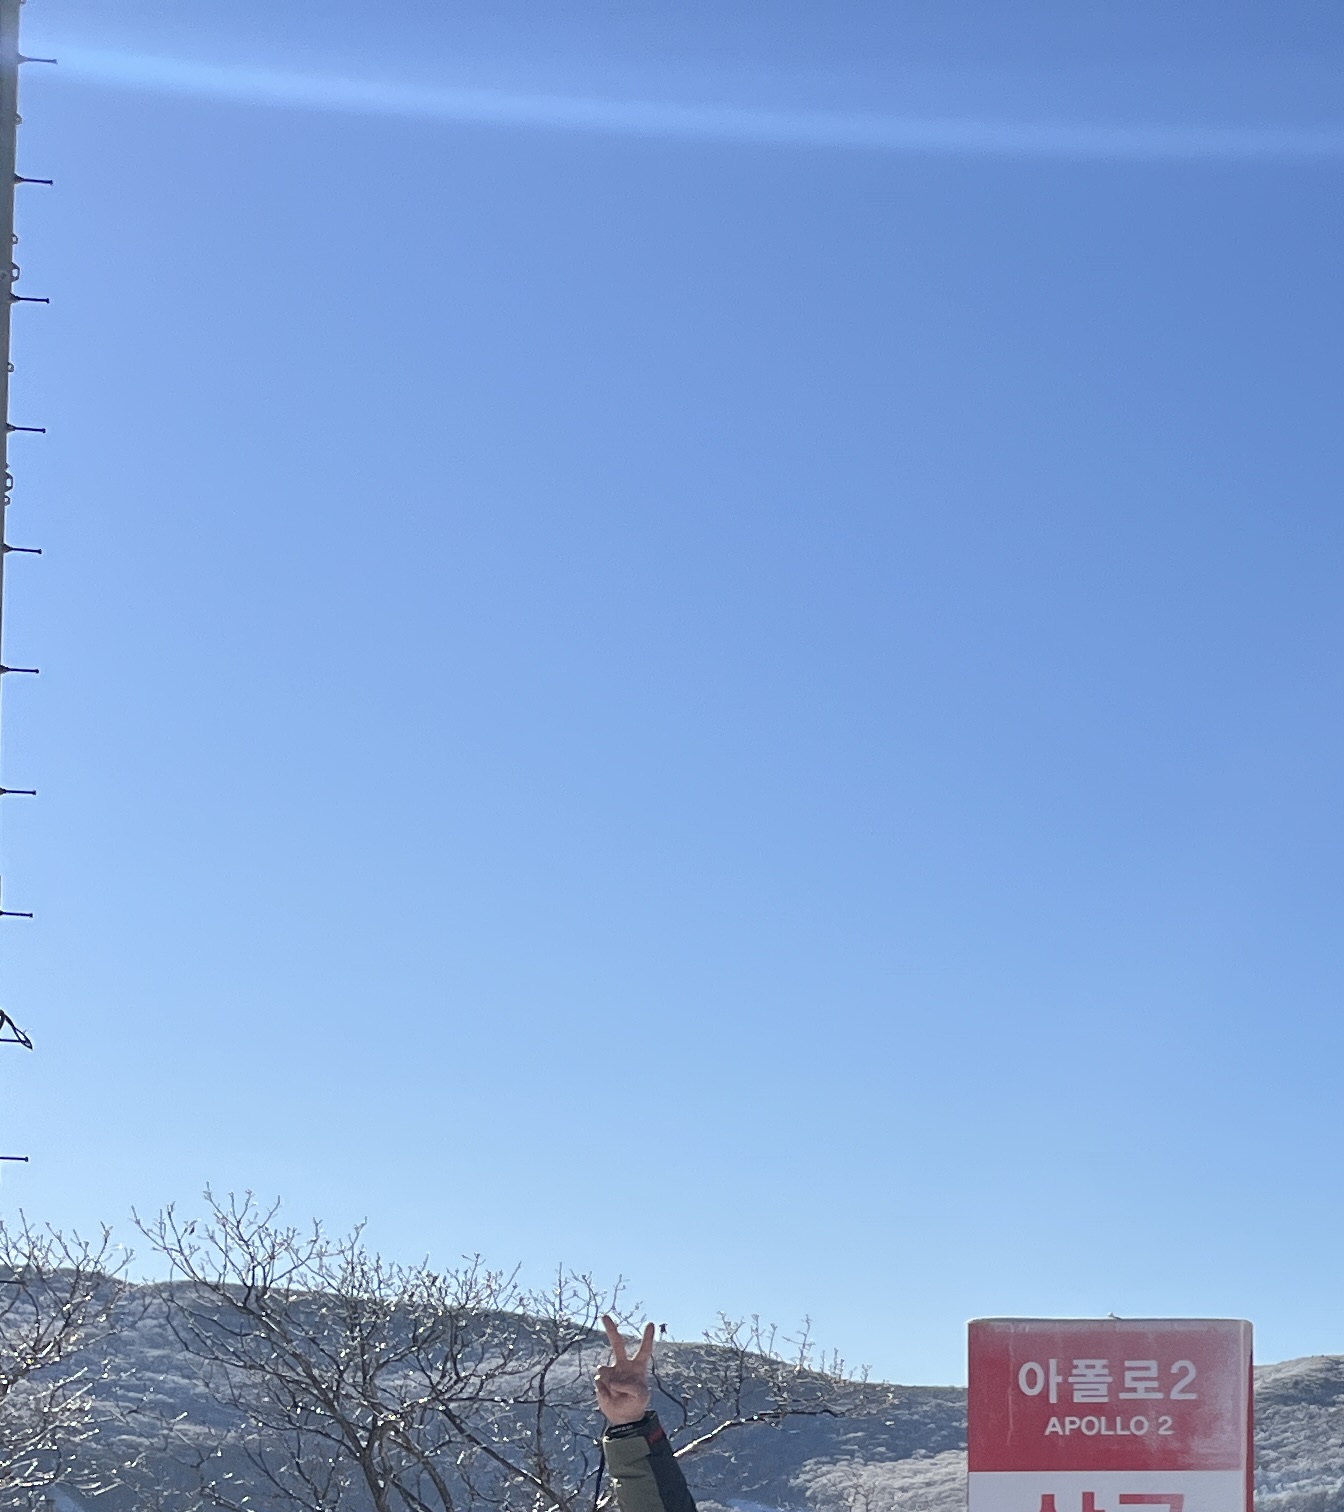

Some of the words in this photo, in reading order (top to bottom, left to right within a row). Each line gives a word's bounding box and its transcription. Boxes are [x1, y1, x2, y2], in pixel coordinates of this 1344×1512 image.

[1018, 1358, 1198, 1403] 아폴로2
[1044, 1415, 1149, 1436] APOLLO
[1158, 1415, 1174, 1436] 2
